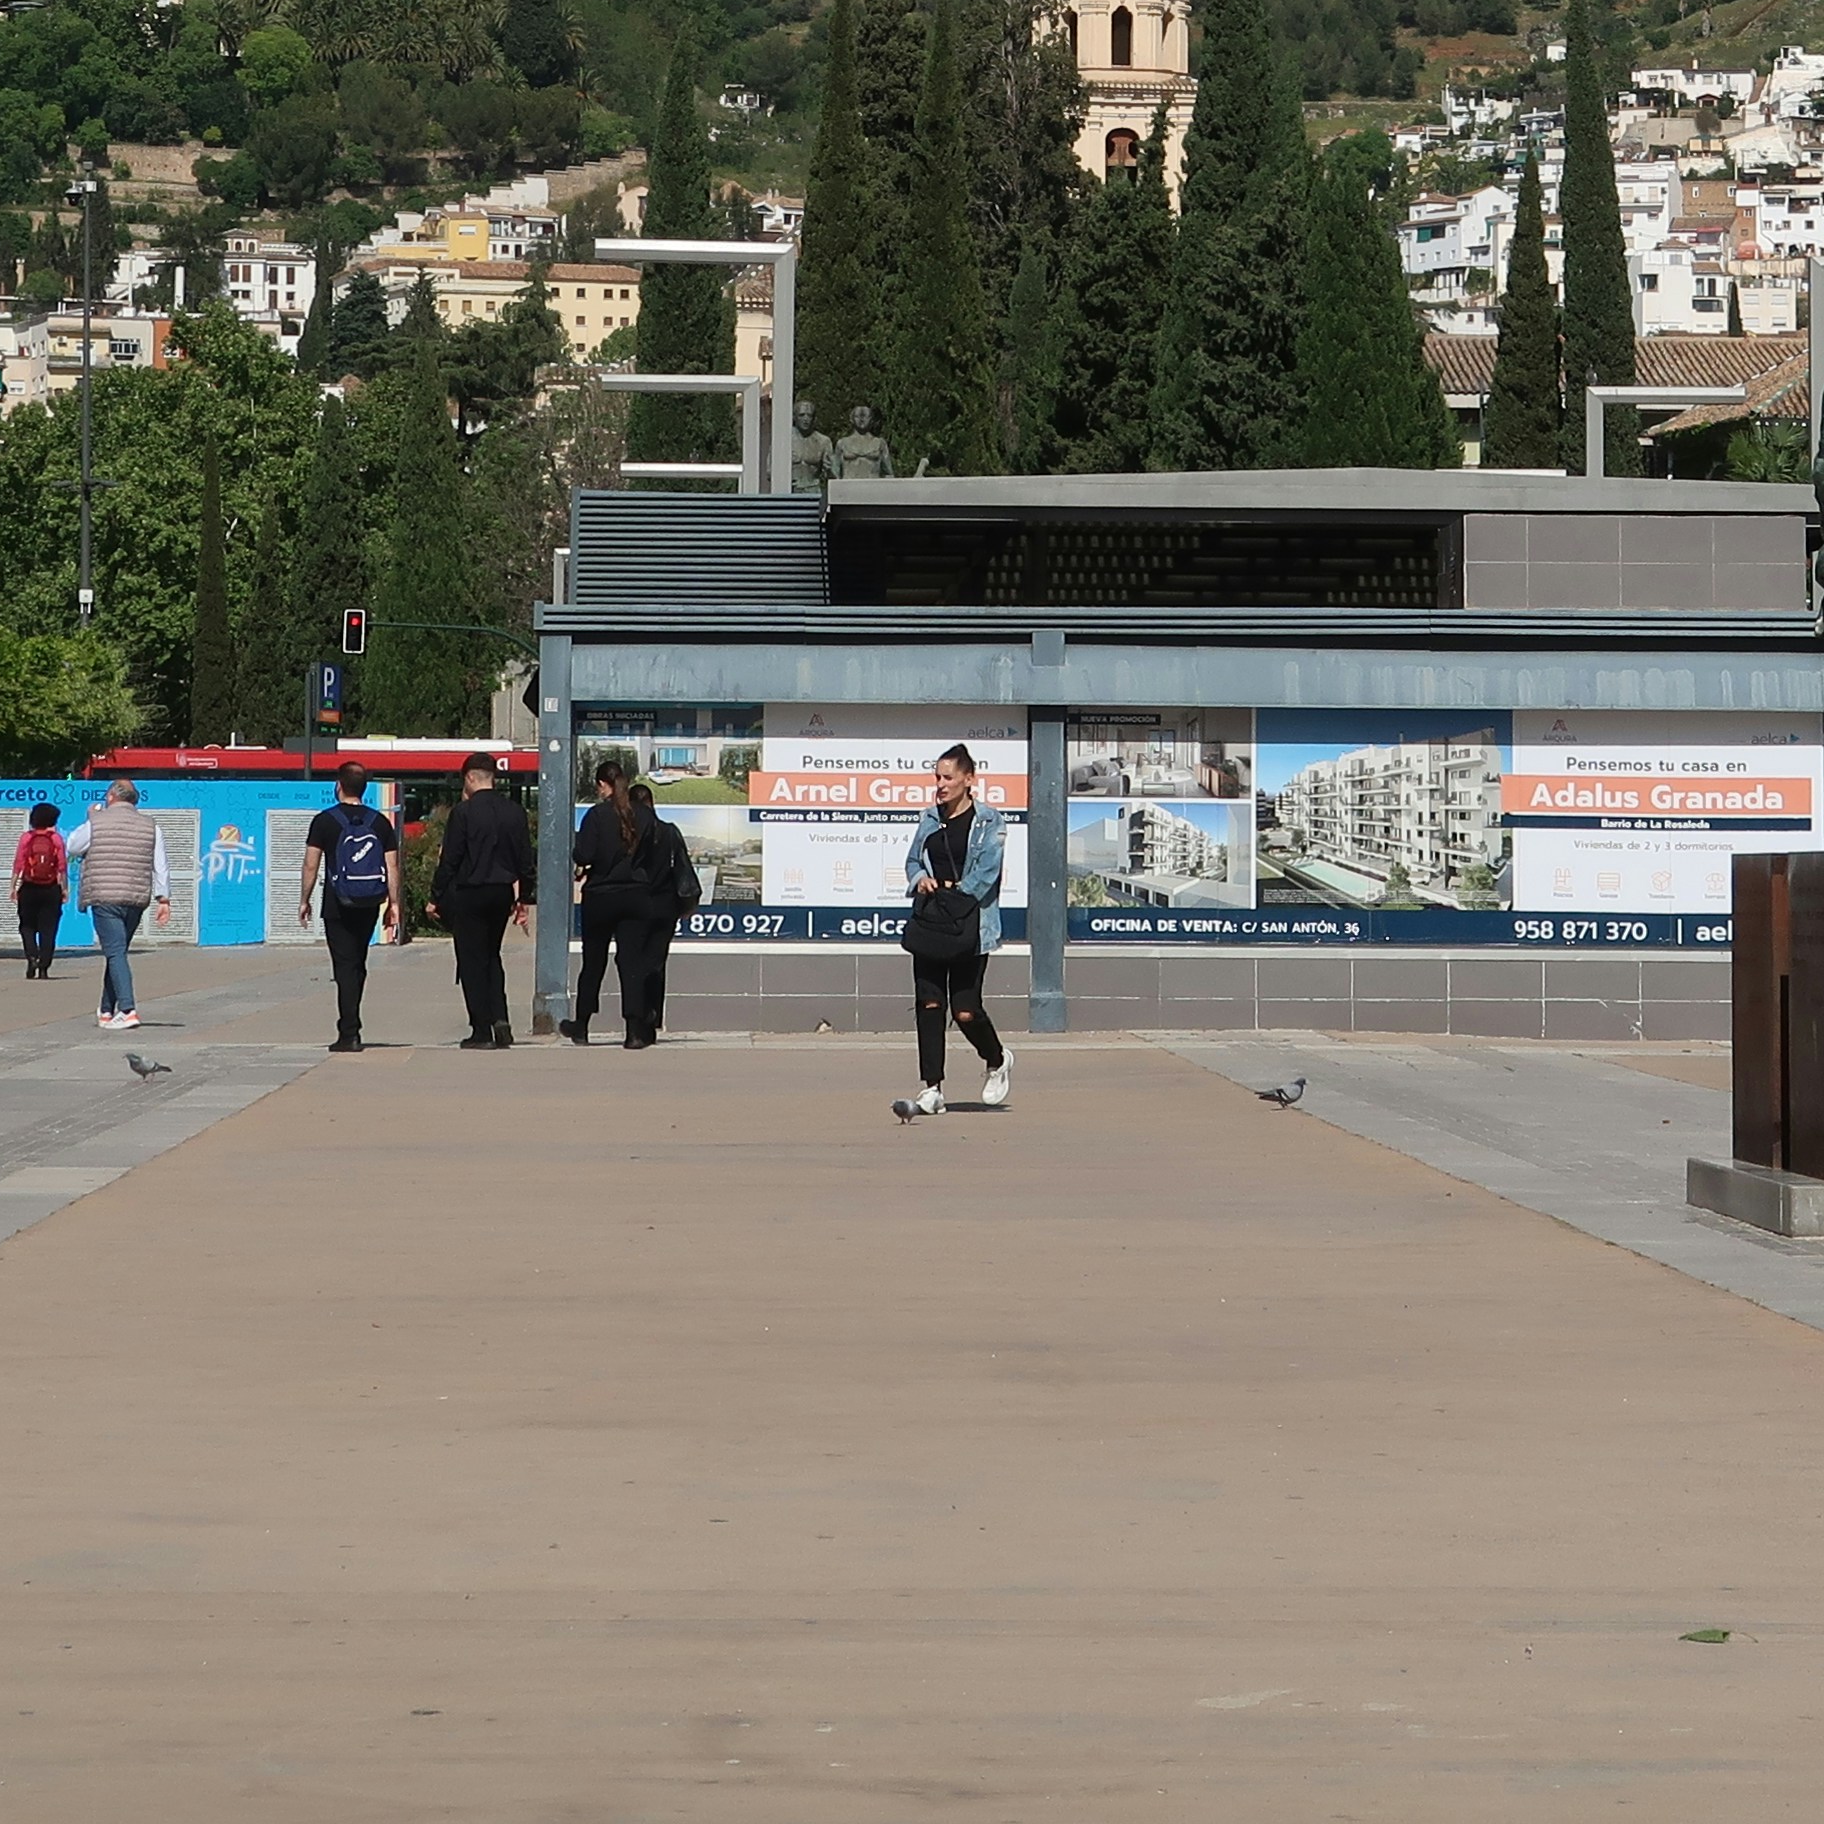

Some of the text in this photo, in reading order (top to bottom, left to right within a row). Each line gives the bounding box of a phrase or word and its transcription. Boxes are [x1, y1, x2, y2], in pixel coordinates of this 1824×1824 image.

[323, 667, 335, 697] P
[586, 712, 655, 720] OBRAS INICIADAS
[1081, 714, 1156, 723] NUEVA PROMOCIÓN
[967, 726, 1005, 739] aelca
[1751, 732, 1788, 745] aelca
[802, 755, 890, 770] Pensemos
[897, 757, 914, 770] tu
[1566, 756, 1747, 773] Pensemos tu casa en
[81, 789, 108, 801] DIEZ
[769, 777, 857, 803] Arnel
[1530, 782, 1784, 810] Adalus Granada
[759, 811, 920, 824] Carretera de la Sierra, junto nuevo
[1600, 819, 1710, 830] Barrio de La Rosaleda
[808, 833, 909, 845] Viviendas de 3 y 4
[1574, 840, 1734, 853] Viviendas de 2 y 3 dormitorios
[690, 914, 734, 933] 870
[742, 914, 784, 934] 927
[1090, 919, 1360, 935] OFICINA DE VENTA: C/ SAN ANTÓN, 36
[1514, 920, 1648, 941] 958 871 370
